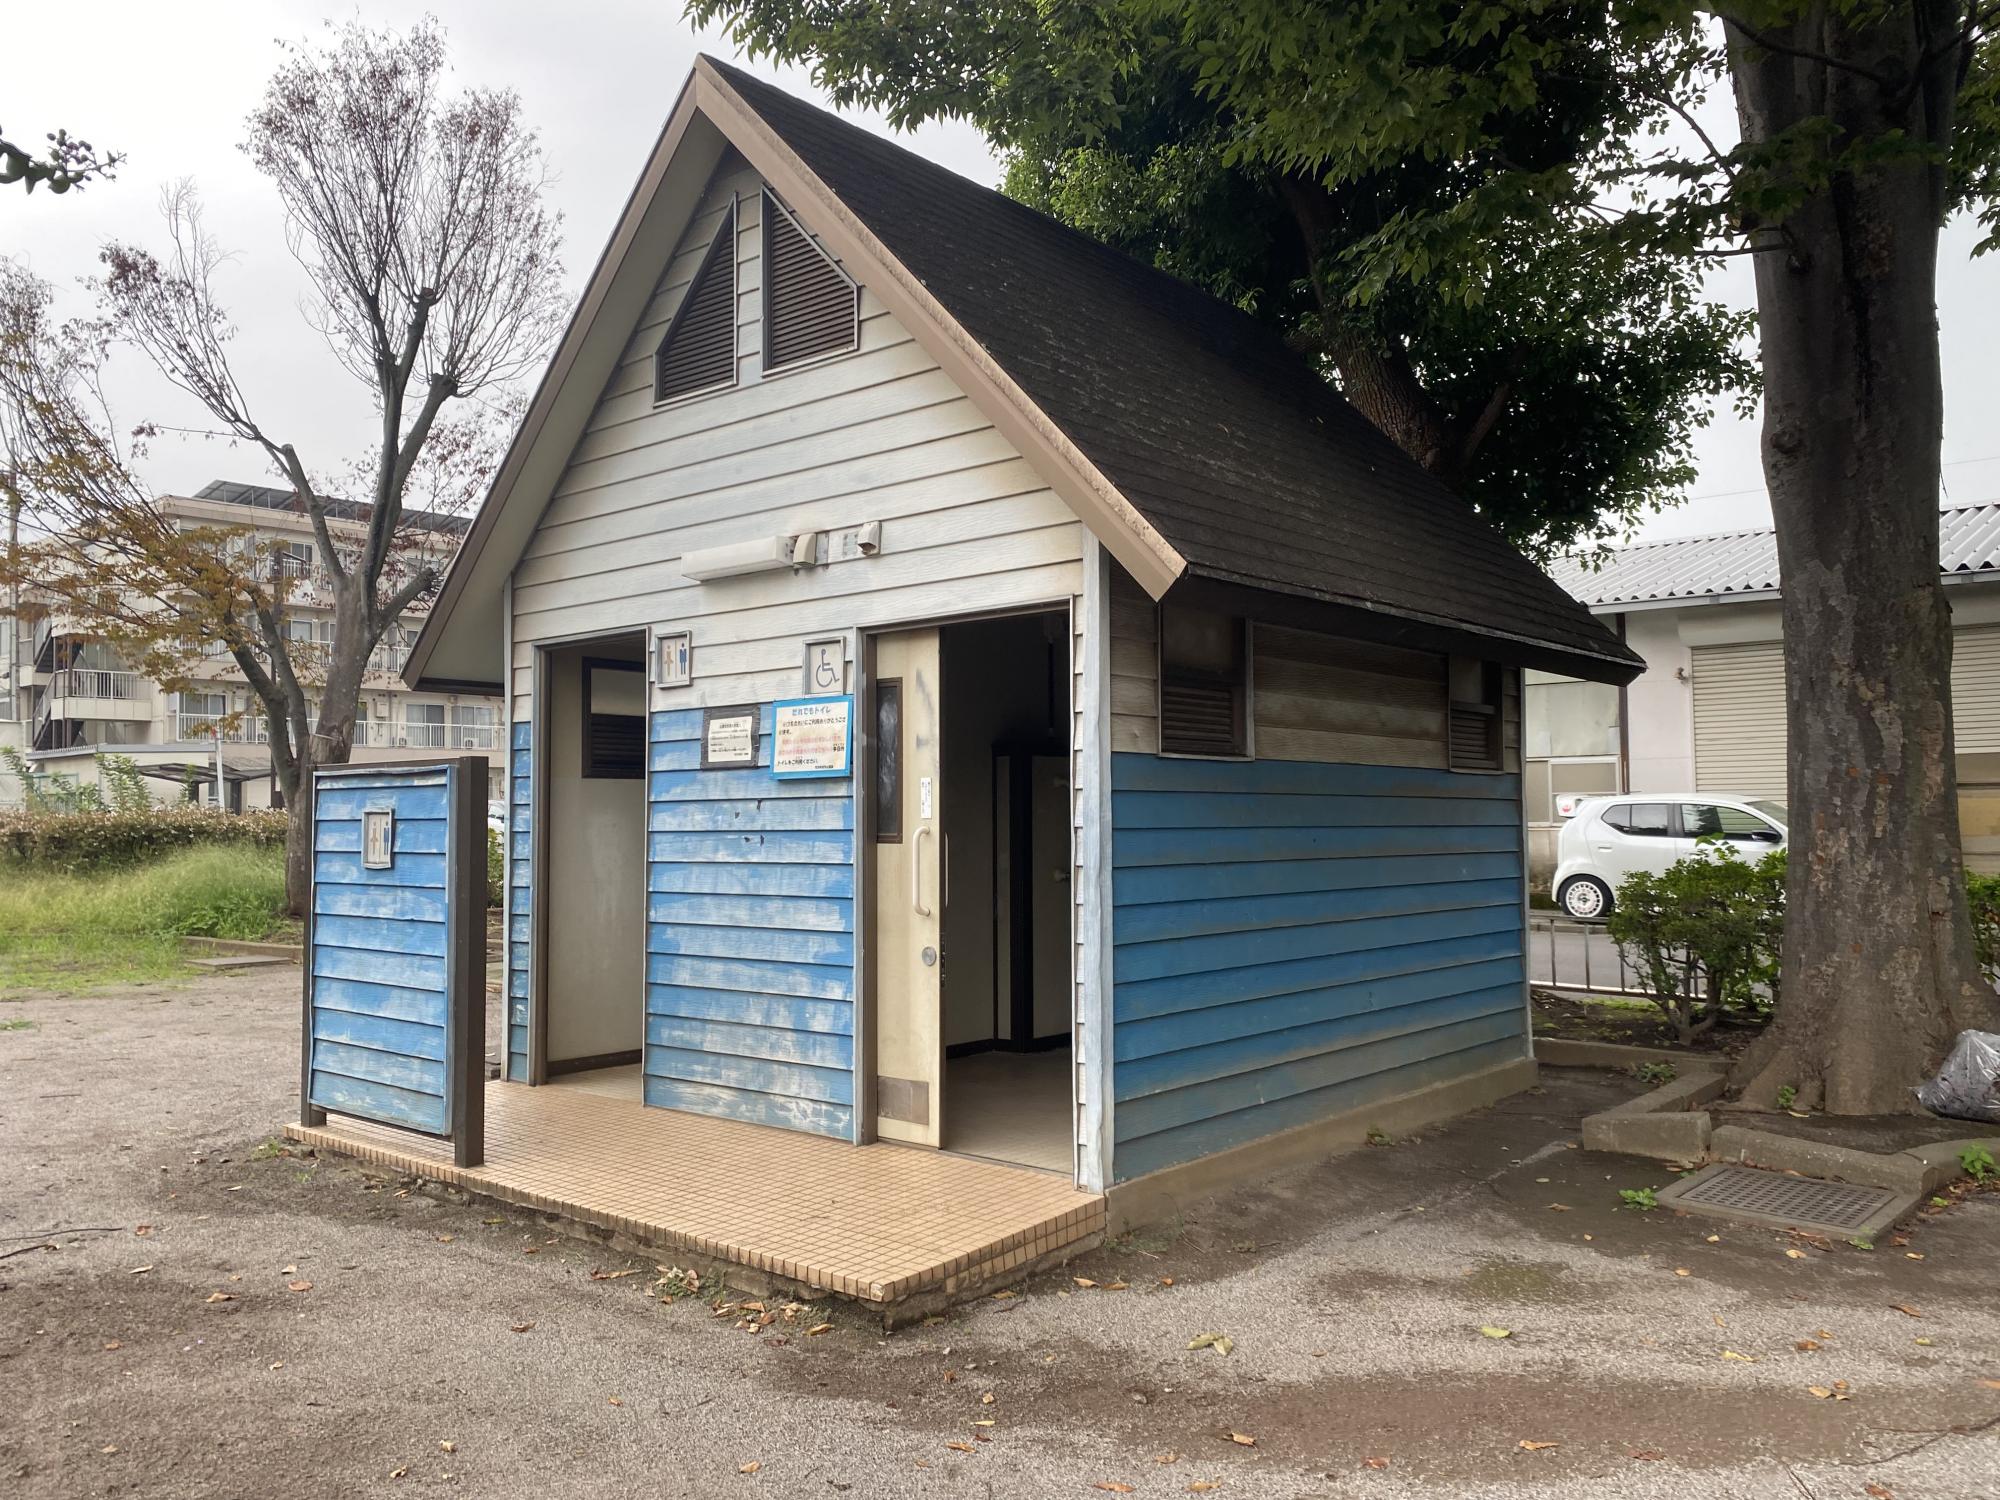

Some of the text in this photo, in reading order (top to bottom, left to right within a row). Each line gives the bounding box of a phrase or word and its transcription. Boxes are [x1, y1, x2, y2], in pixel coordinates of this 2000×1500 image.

[792, 705, 831, 716] だれでもトイレ
